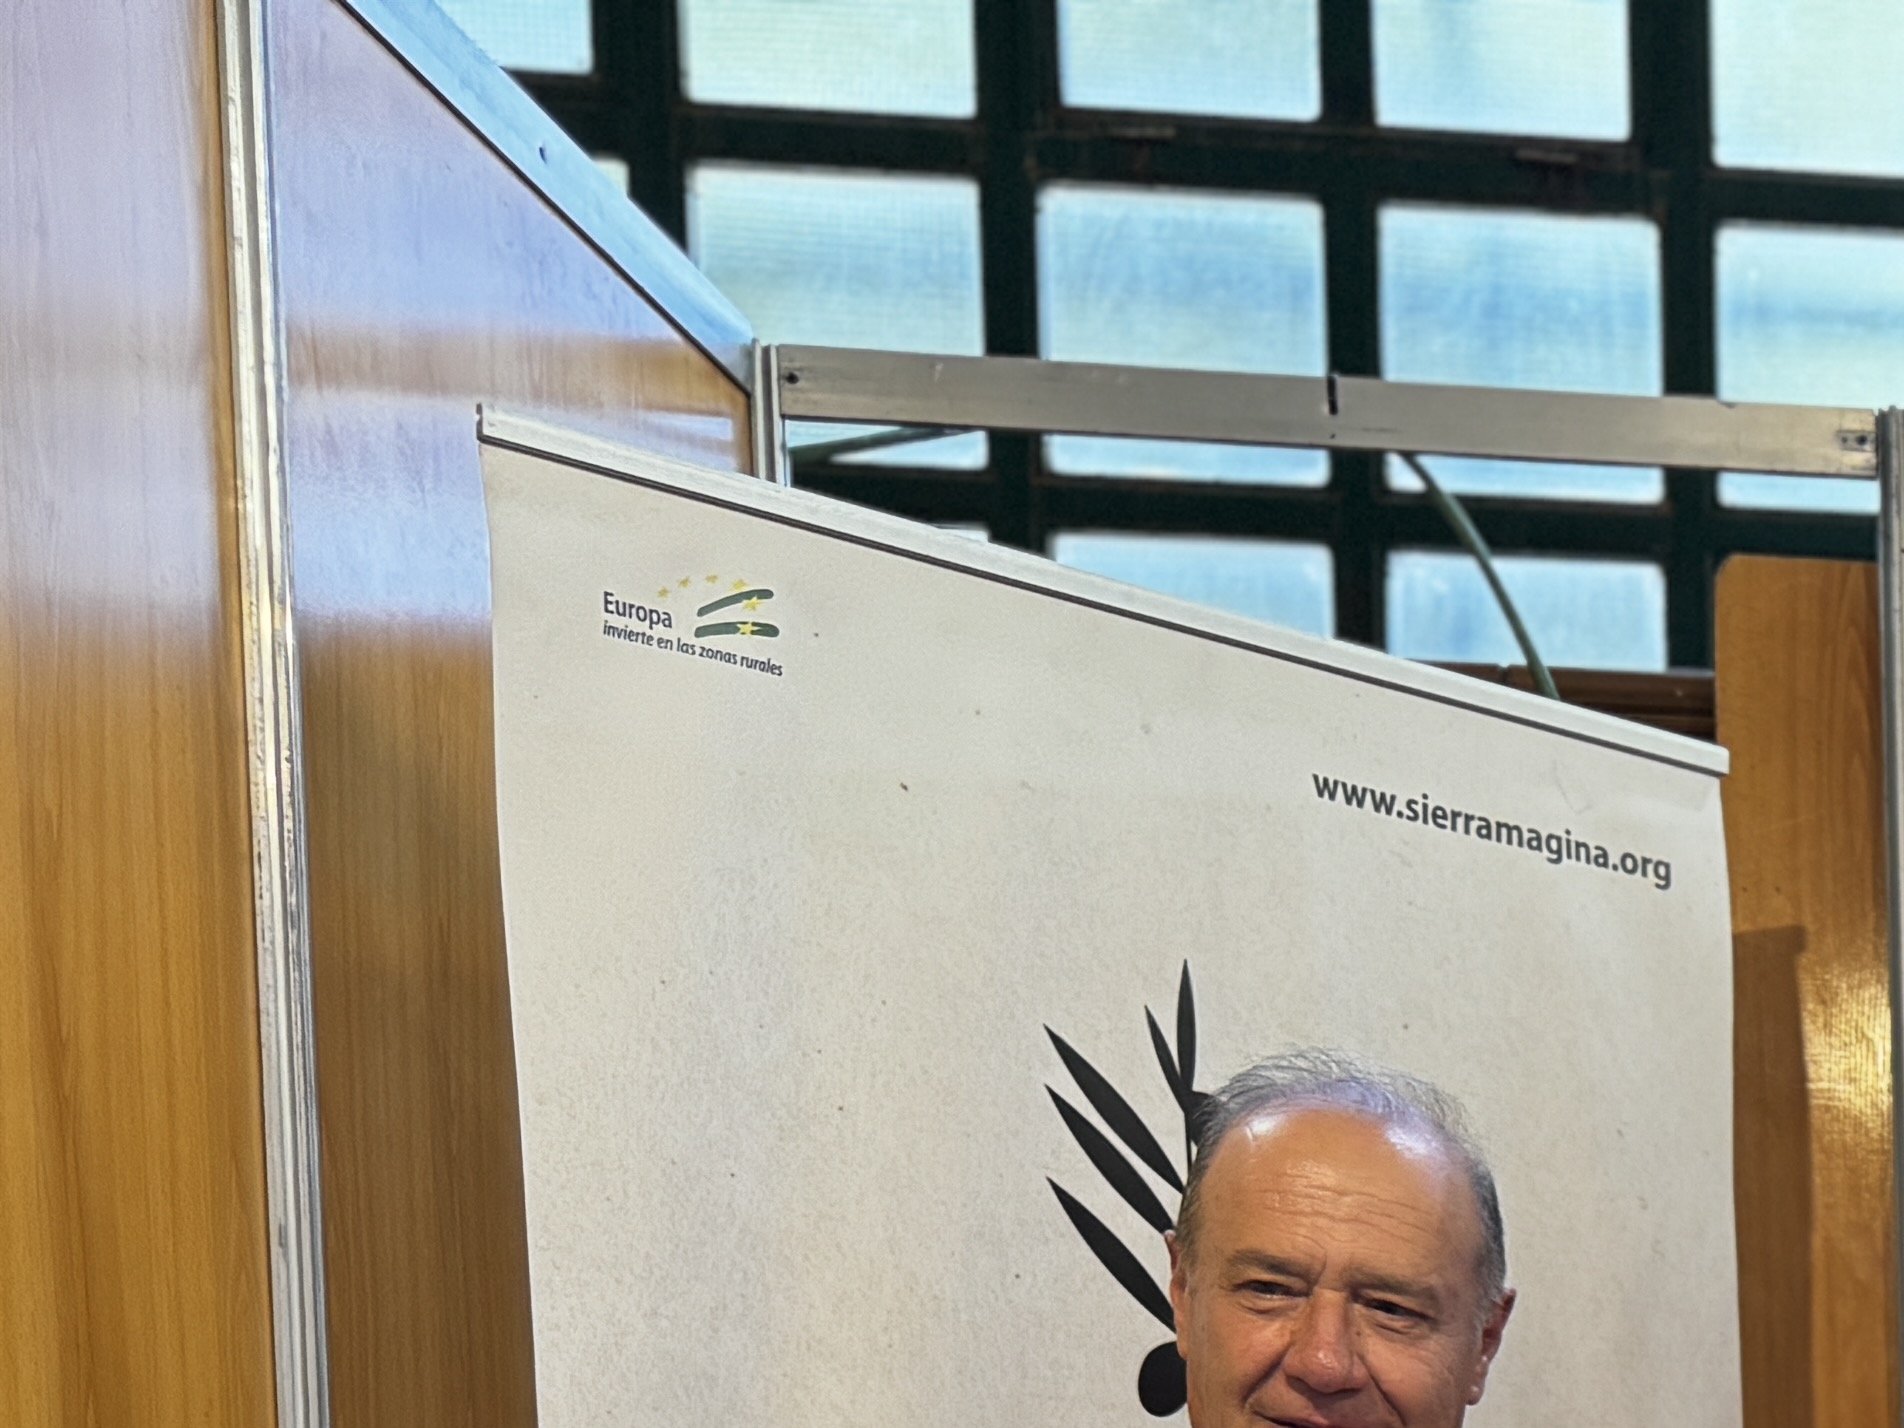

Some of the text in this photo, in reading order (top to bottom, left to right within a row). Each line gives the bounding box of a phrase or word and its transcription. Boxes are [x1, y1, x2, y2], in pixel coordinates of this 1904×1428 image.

[603, 590, 673, 630] Europa
[603, 620, 783, 677] invierte en las zonas rurales
[1311, 768, 1673, 891] www.sierramagina.org
